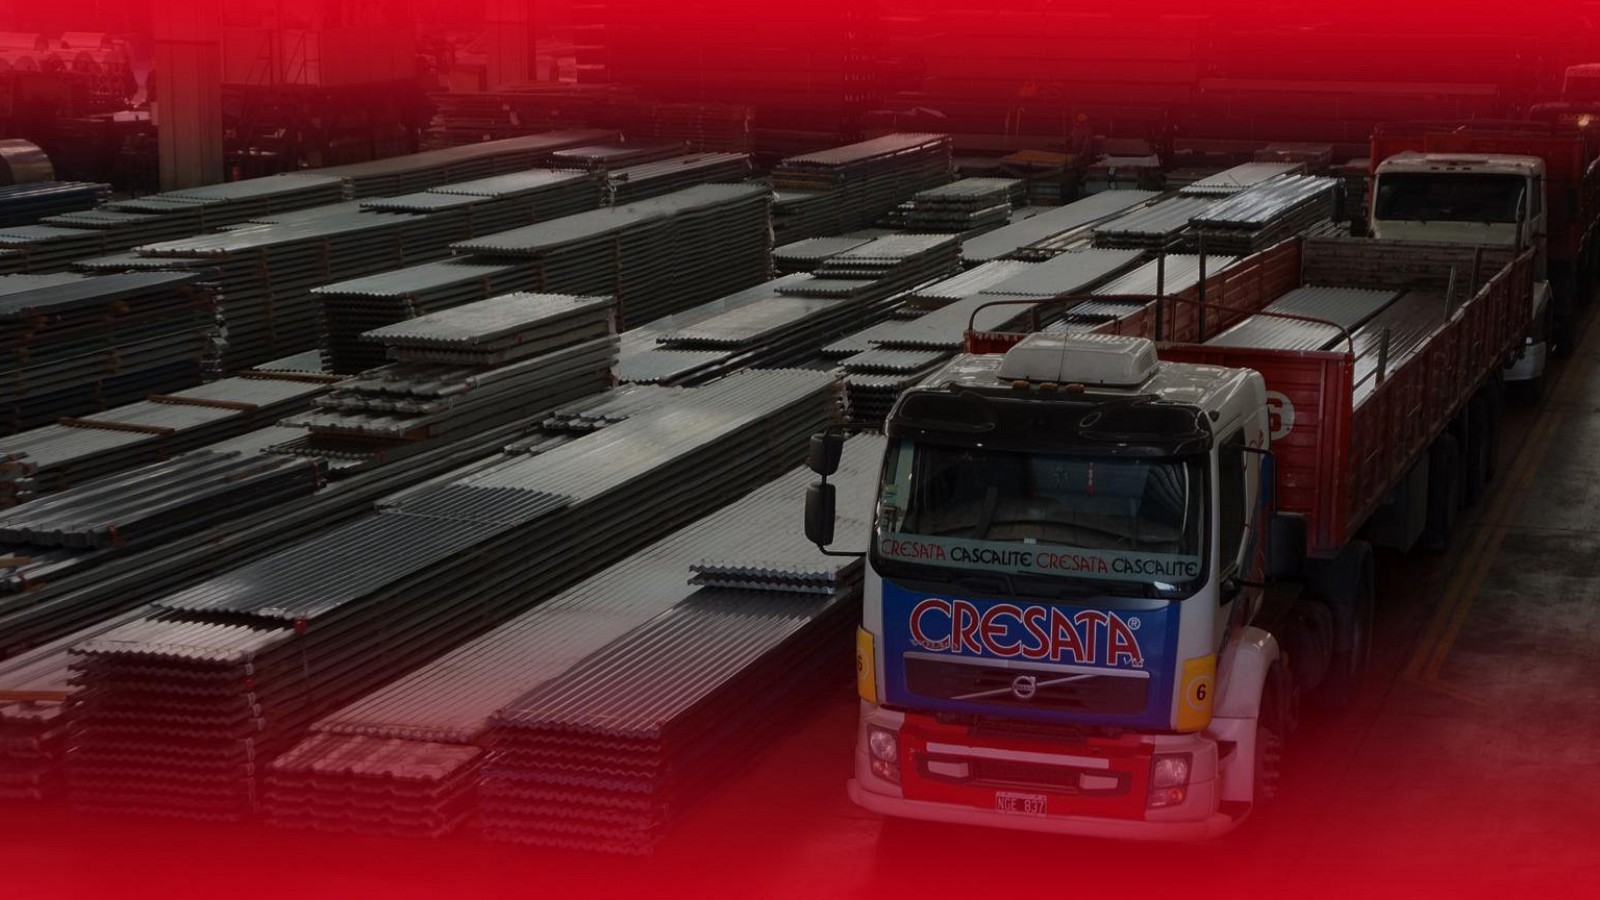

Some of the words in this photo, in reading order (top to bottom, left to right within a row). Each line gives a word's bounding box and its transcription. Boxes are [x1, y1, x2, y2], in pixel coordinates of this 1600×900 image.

[881, 539, 946, 560] CRESATA
[950, 546, 1032, 567] CASCALITE
[1036, 552, 1108, 573] CRESATA
[1112, 557, 1198, 577] CASCALITE
[1196, 683, 1207, 701] 6
[997, 797, 1017, 811] NGE
[1024, 799, 1045, 814] 837
